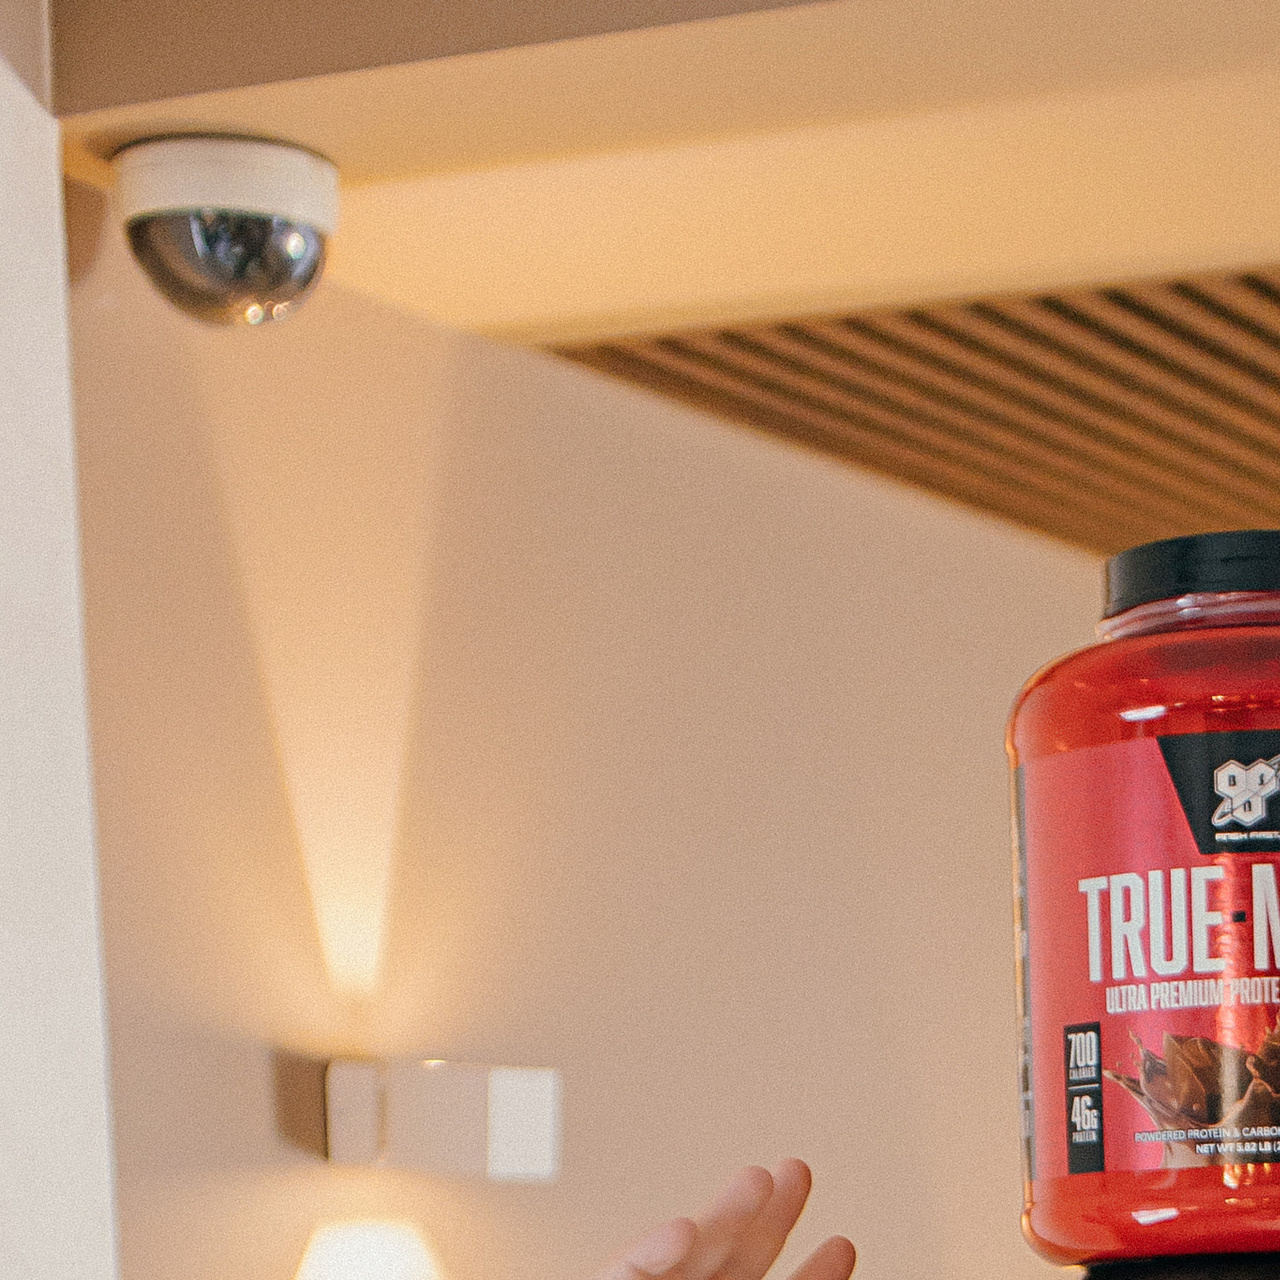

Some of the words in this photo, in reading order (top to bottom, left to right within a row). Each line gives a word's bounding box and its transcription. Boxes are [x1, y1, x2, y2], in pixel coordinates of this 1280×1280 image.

[1106, 984, 1148, 1014] ULTRA
[1150, 978, 1224, 1010] PREMIUM
[1068, 1031, 1097, 1068] 700
[1135, 1130, 1186, 1142] POWDERED
[1187, 1127, 1230, 1139] PROTEIN
[1195, 1143, 1216, 1154] NET
[1217, 1143, 1234, 1154] WT
[1235, 1142, 1257, 1153] 5.82
[1258, 1141, 1272, 1151] LB
